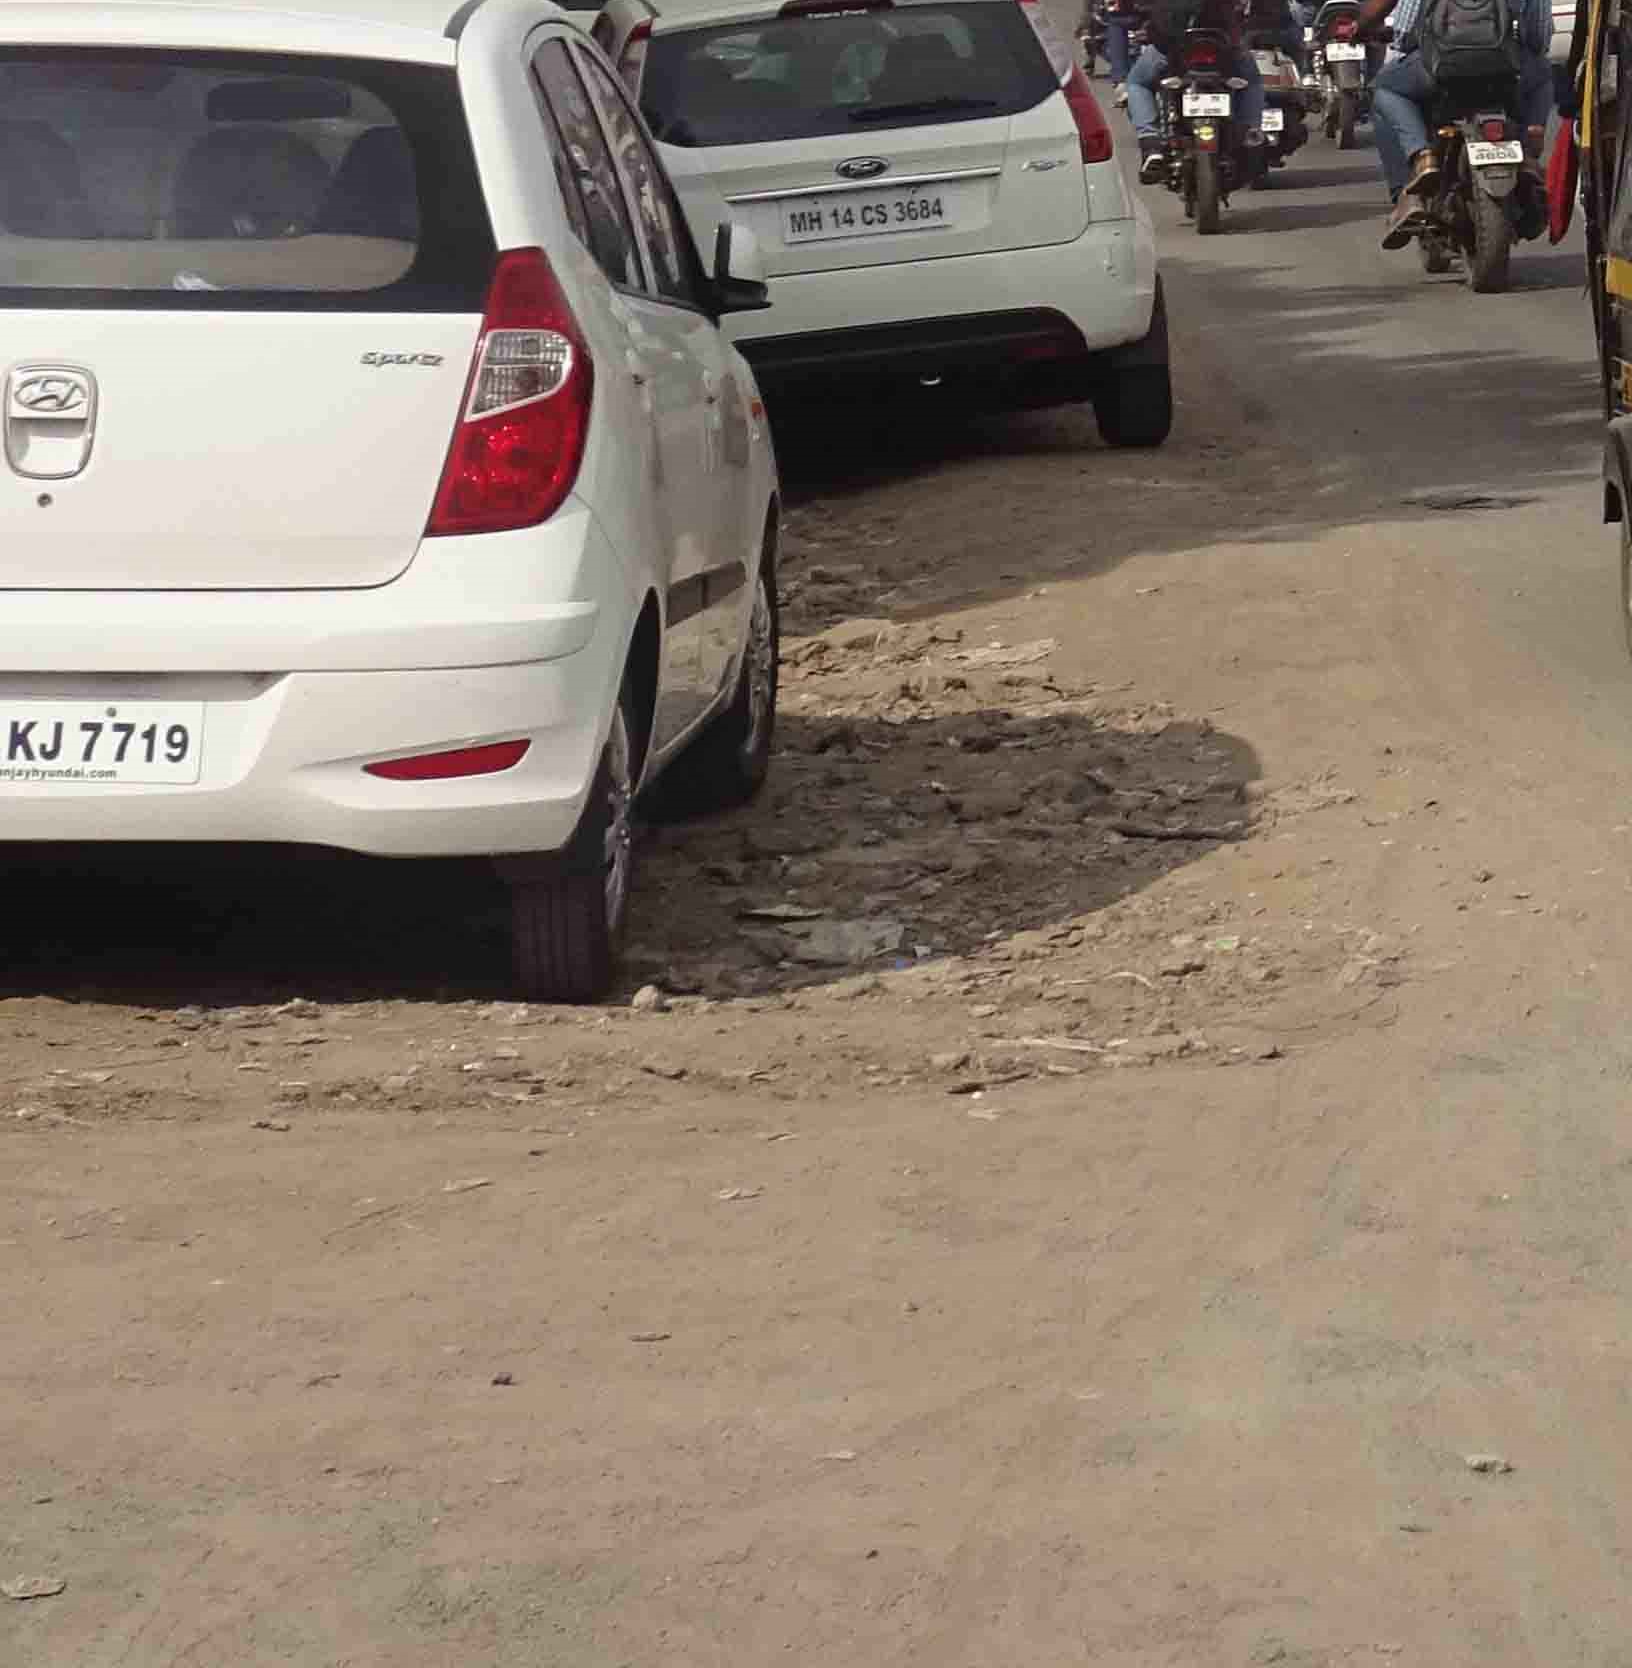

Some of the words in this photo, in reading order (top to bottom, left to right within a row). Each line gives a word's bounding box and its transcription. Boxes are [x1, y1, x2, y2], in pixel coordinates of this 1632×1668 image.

[789, 212, 823, 233] MH
[831, 207, 855, 228] 14
[860, 204, 888, 226] CS
[895, 197, 944, 223] 3684
[7, 720, 65, 762] KJ
[79, 721, 190, 764] 7719
